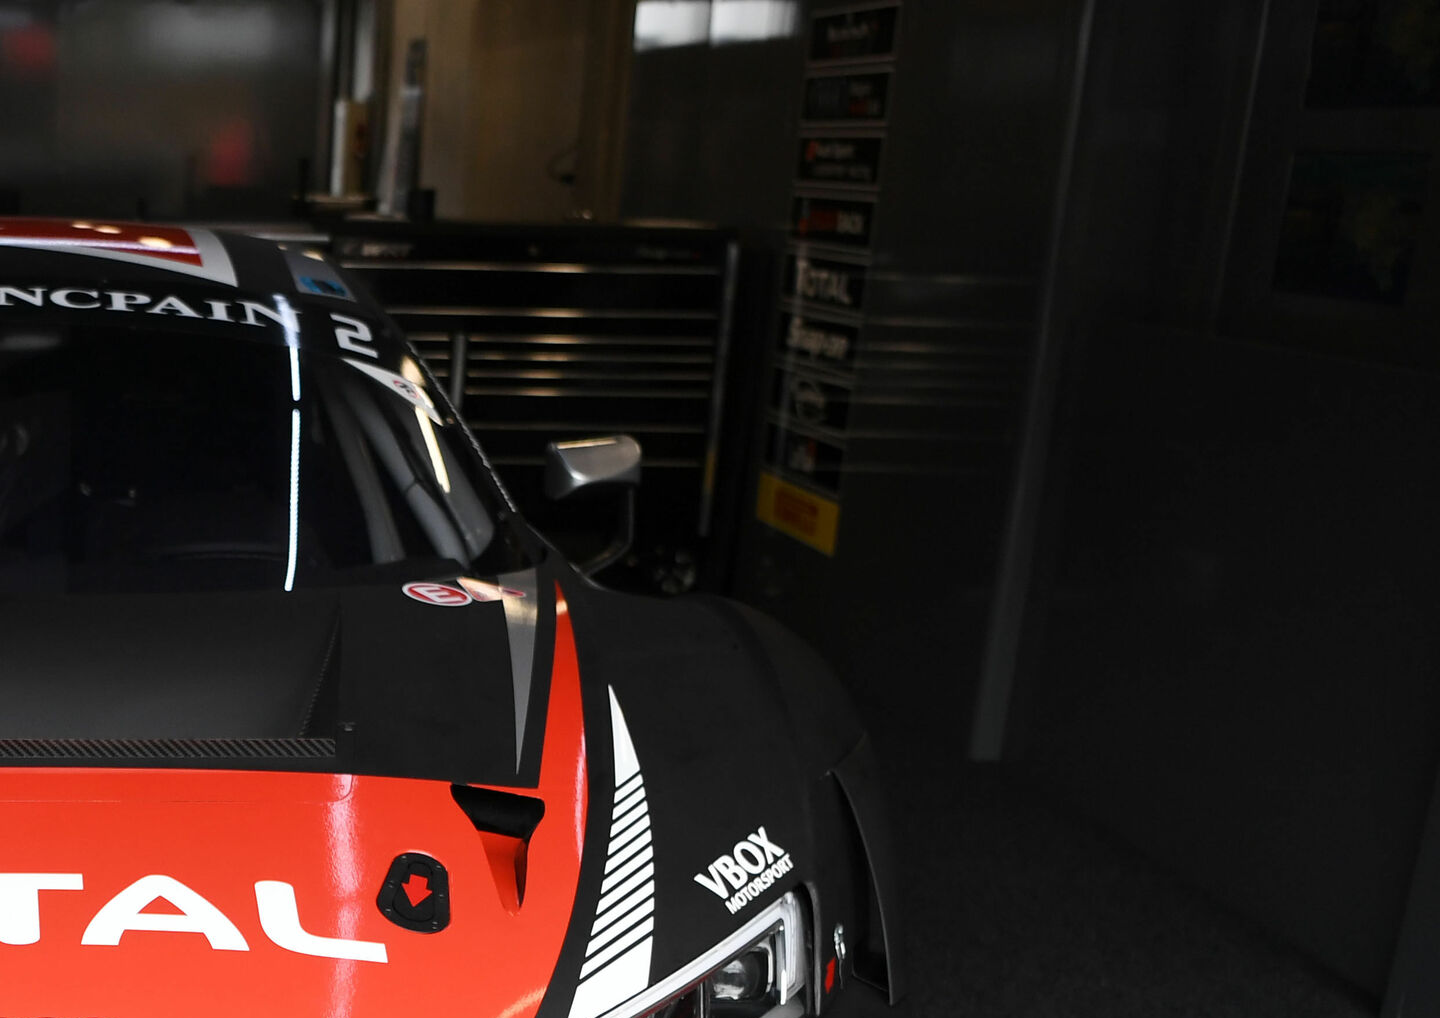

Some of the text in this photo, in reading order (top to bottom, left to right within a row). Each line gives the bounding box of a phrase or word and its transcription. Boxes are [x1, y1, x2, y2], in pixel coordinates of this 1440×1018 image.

[329, 312, 379, 359] 2
[694, 826, 785, 899] VBOX
[725, 853, 794, 914] MOTORSPORT
